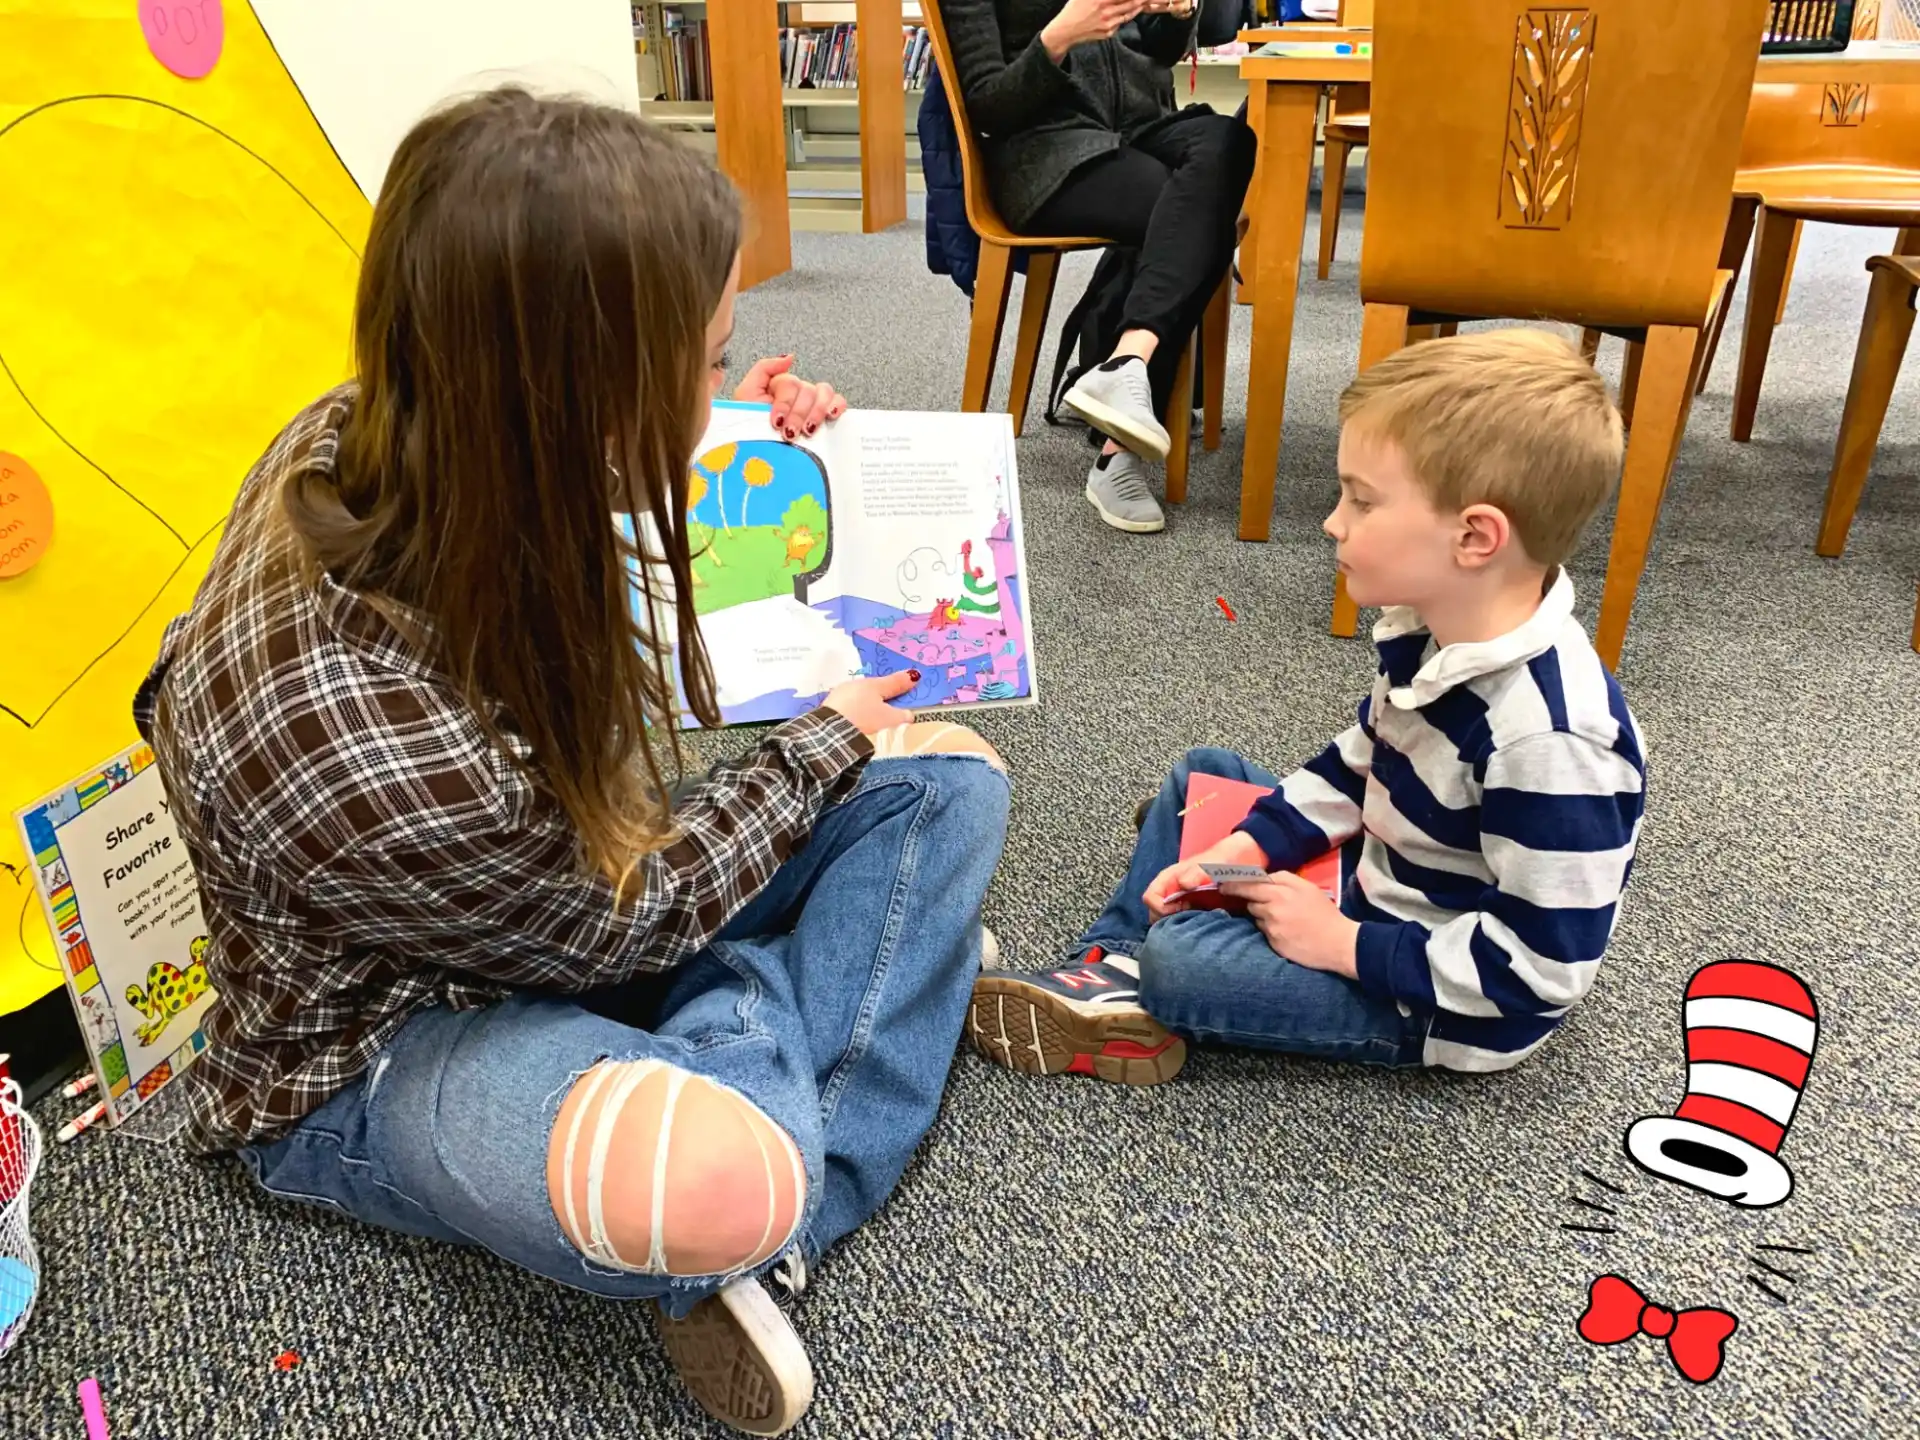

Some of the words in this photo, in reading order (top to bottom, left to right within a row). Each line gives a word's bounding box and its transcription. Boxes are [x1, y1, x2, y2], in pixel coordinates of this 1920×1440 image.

[105, 811, 156, 851] Share
[102, 836, 172, 889] Favorite
[117, 899, 134, 913] Can
[135, 887, 150, 903] you
[152, 872, 169, 890] spot
[171, 859, 188, 878] your
[152, 893, 161, 907] If
[129, 923, 148, 941] with
[149, 909, 167, 929] your
[169, 903, 196, 929] friend!
